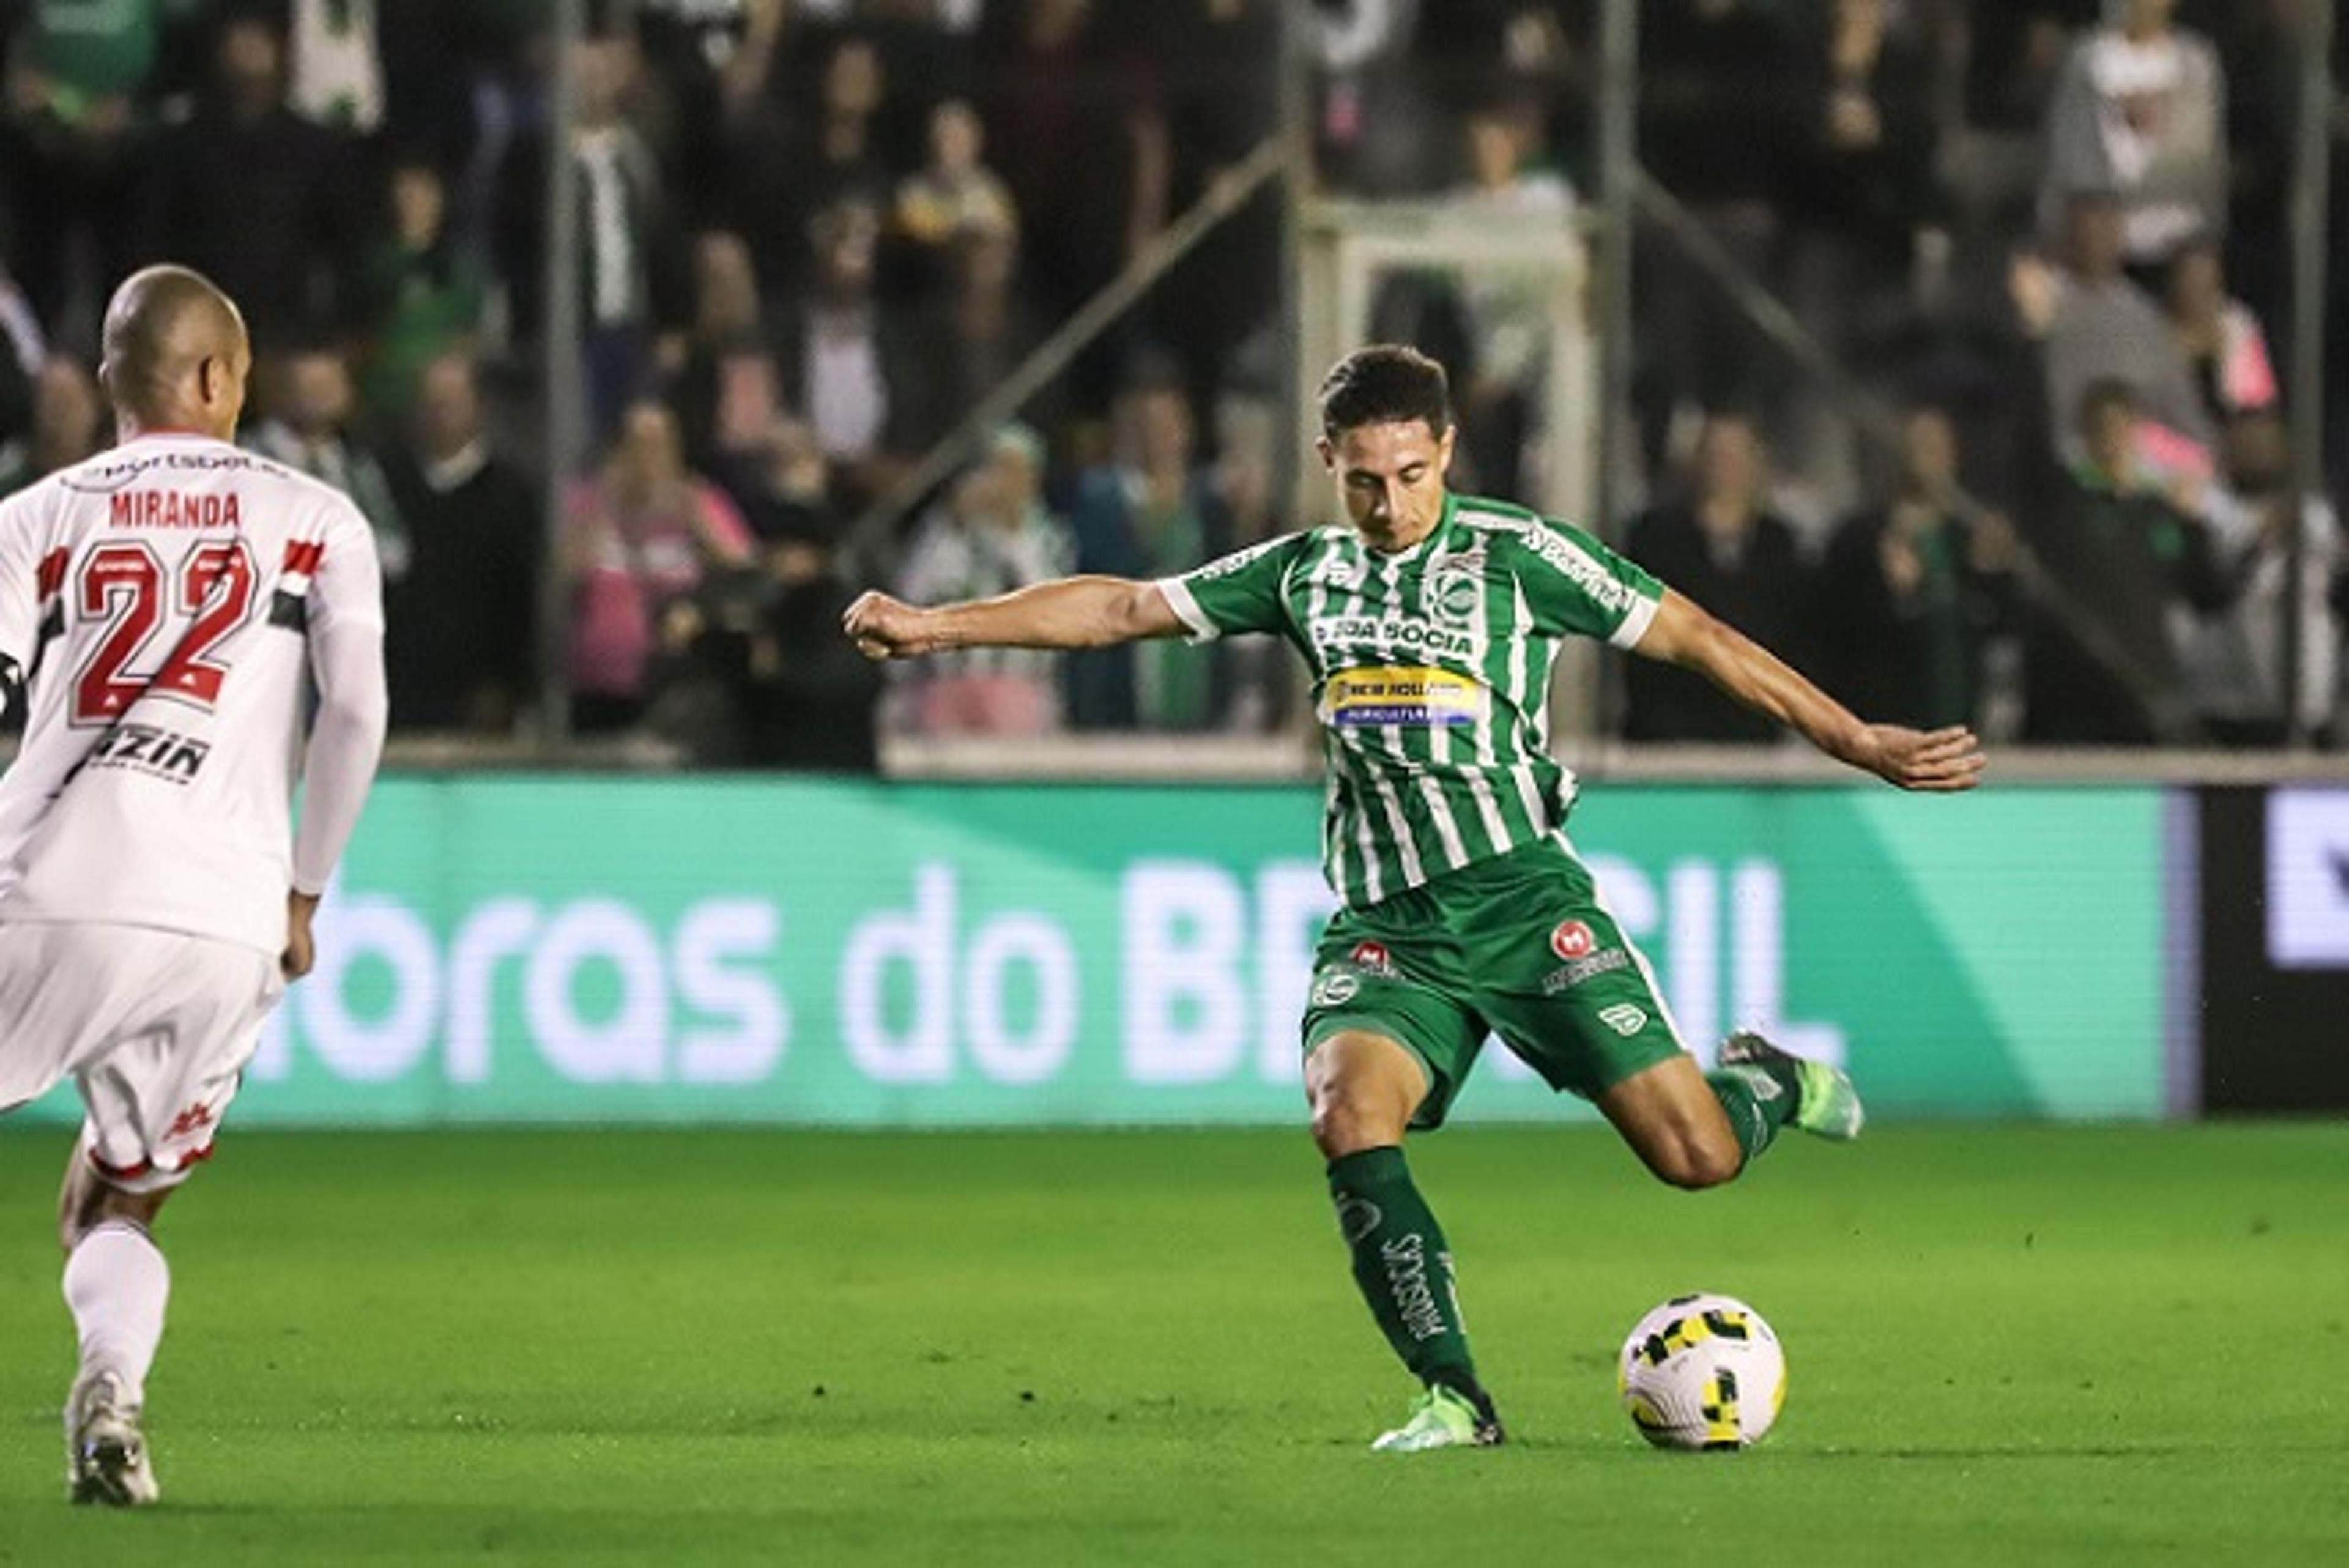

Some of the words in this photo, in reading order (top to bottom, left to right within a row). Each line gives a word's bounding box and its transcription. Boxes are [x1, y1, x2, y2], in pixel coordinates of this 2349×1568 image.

[109, 491, 240, 529] MIRANDA
[69, 537, 260, 728] 22
[1387, 683, 1463, 696] HOLL
[251, 855, 789, 1084] bras
[840, 860, 1080, 1084] do
